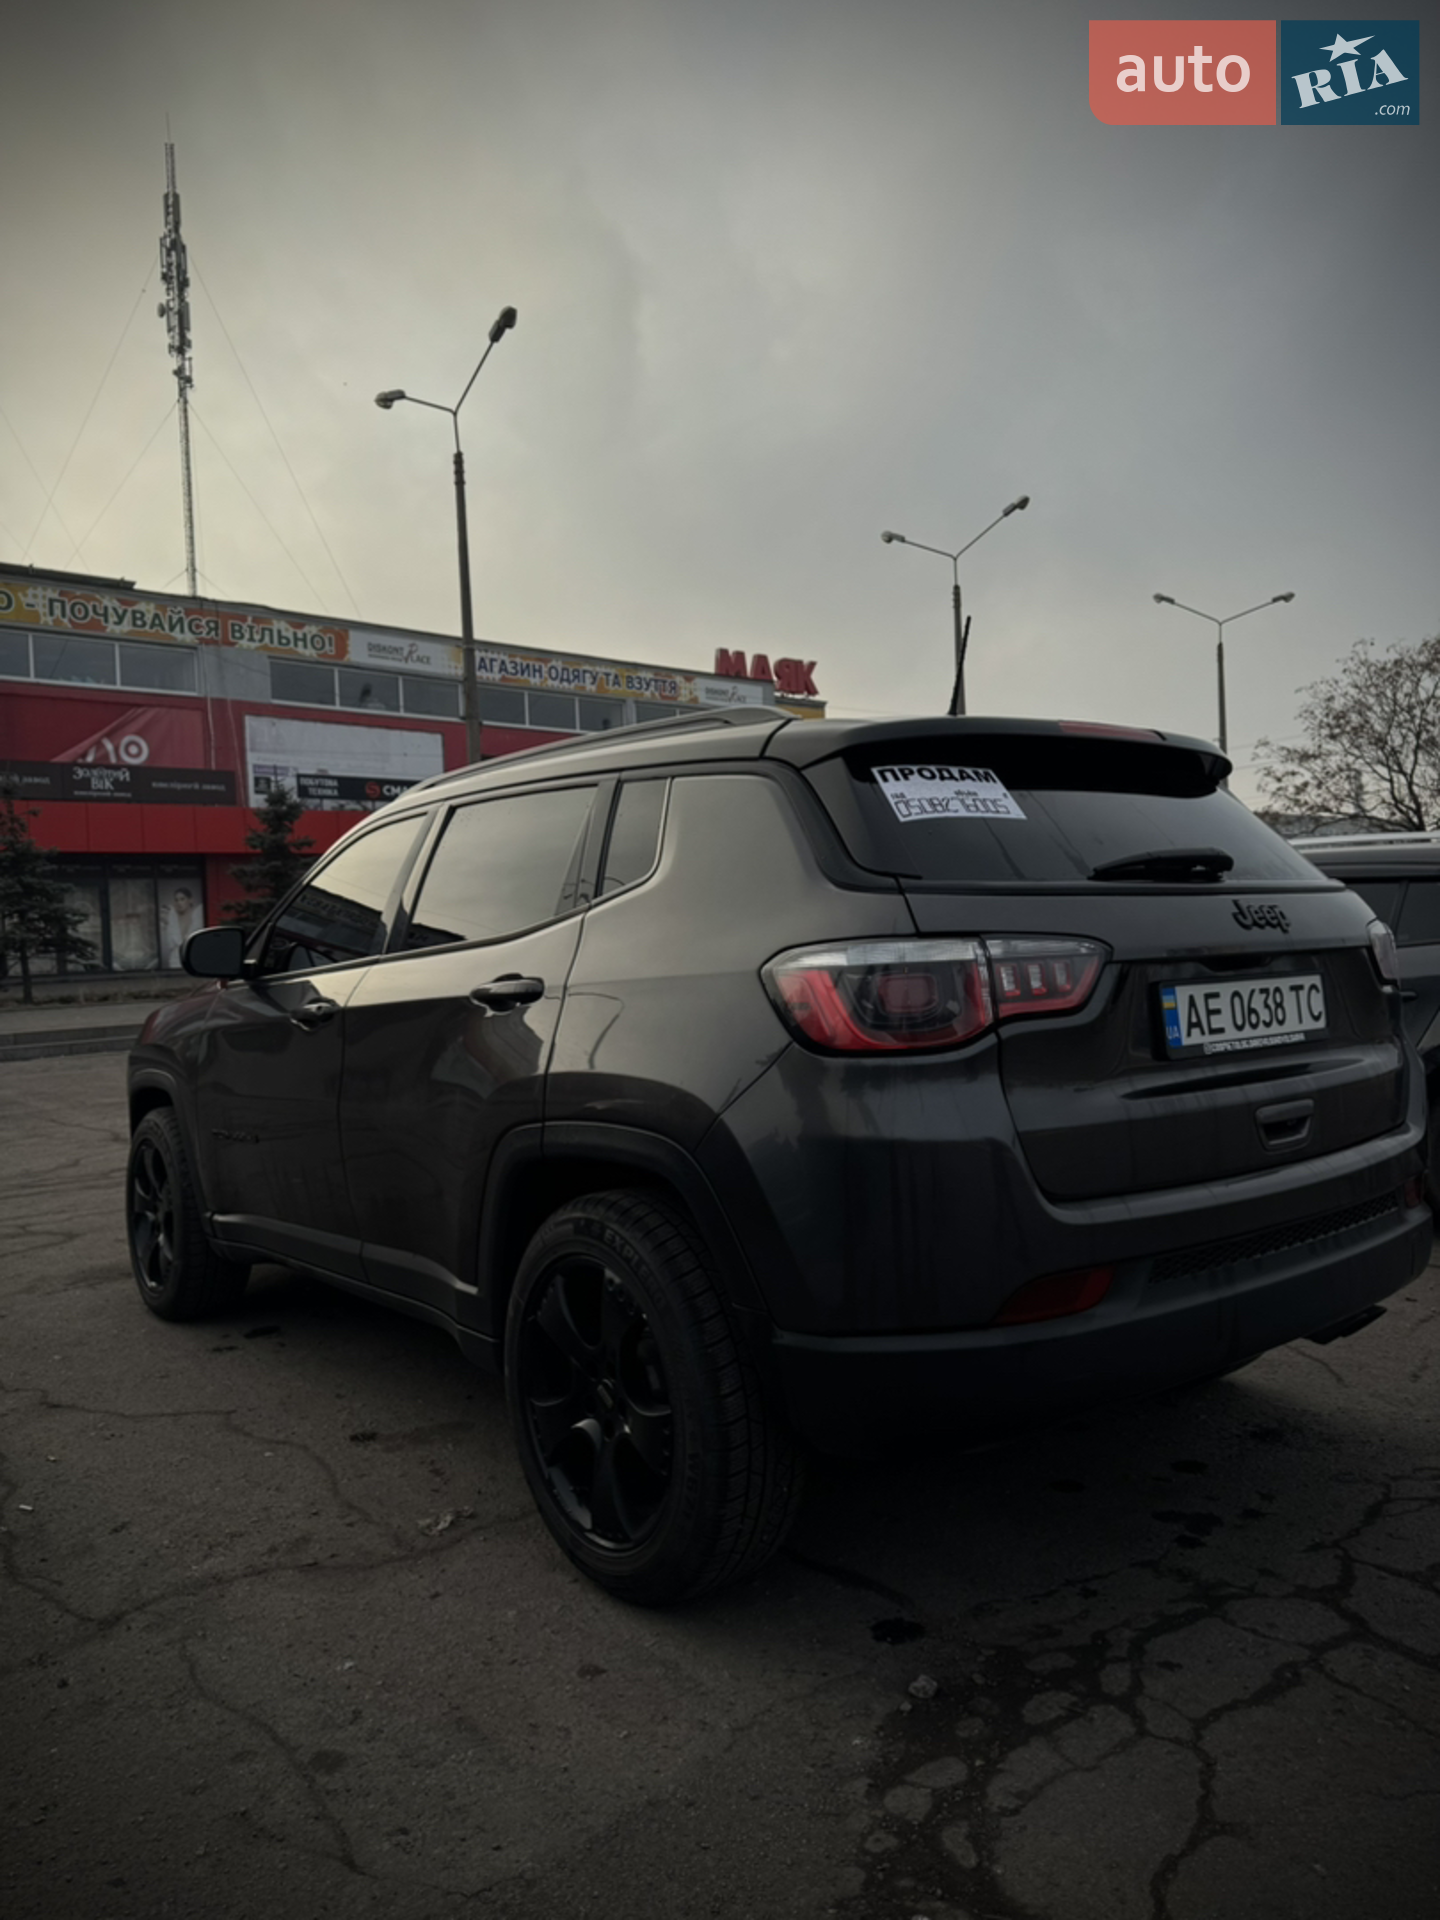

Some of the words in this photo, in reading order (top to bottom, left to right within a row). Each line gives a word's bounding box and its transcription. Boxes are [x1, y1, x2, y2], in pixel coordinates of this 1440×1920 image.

[47, 598, 220, 638] ПОЧУВАЙСЯ
[229, 617, 335, 655] ВІЛЬНО!
[477, 656, 544, 680] АГАЗИН
[548, 665, 598, 687] ОДЯГУ
[603, 671, 622, 688] ТА
[625, 674, 679, 695] ВЗУТТЯ
[714, 647, 819, 696] МАЯК
[877, 766, 997, 784] ПРОДАМ
[1231, 899, 1292, 934] Jeep
[1186, 991, 1226, 1039] AE
[1230, 986, 1287, 1033] 0638
[1288, 983, 1323, 1026] TC
[1166, 1025, 1180, 1040] UA
